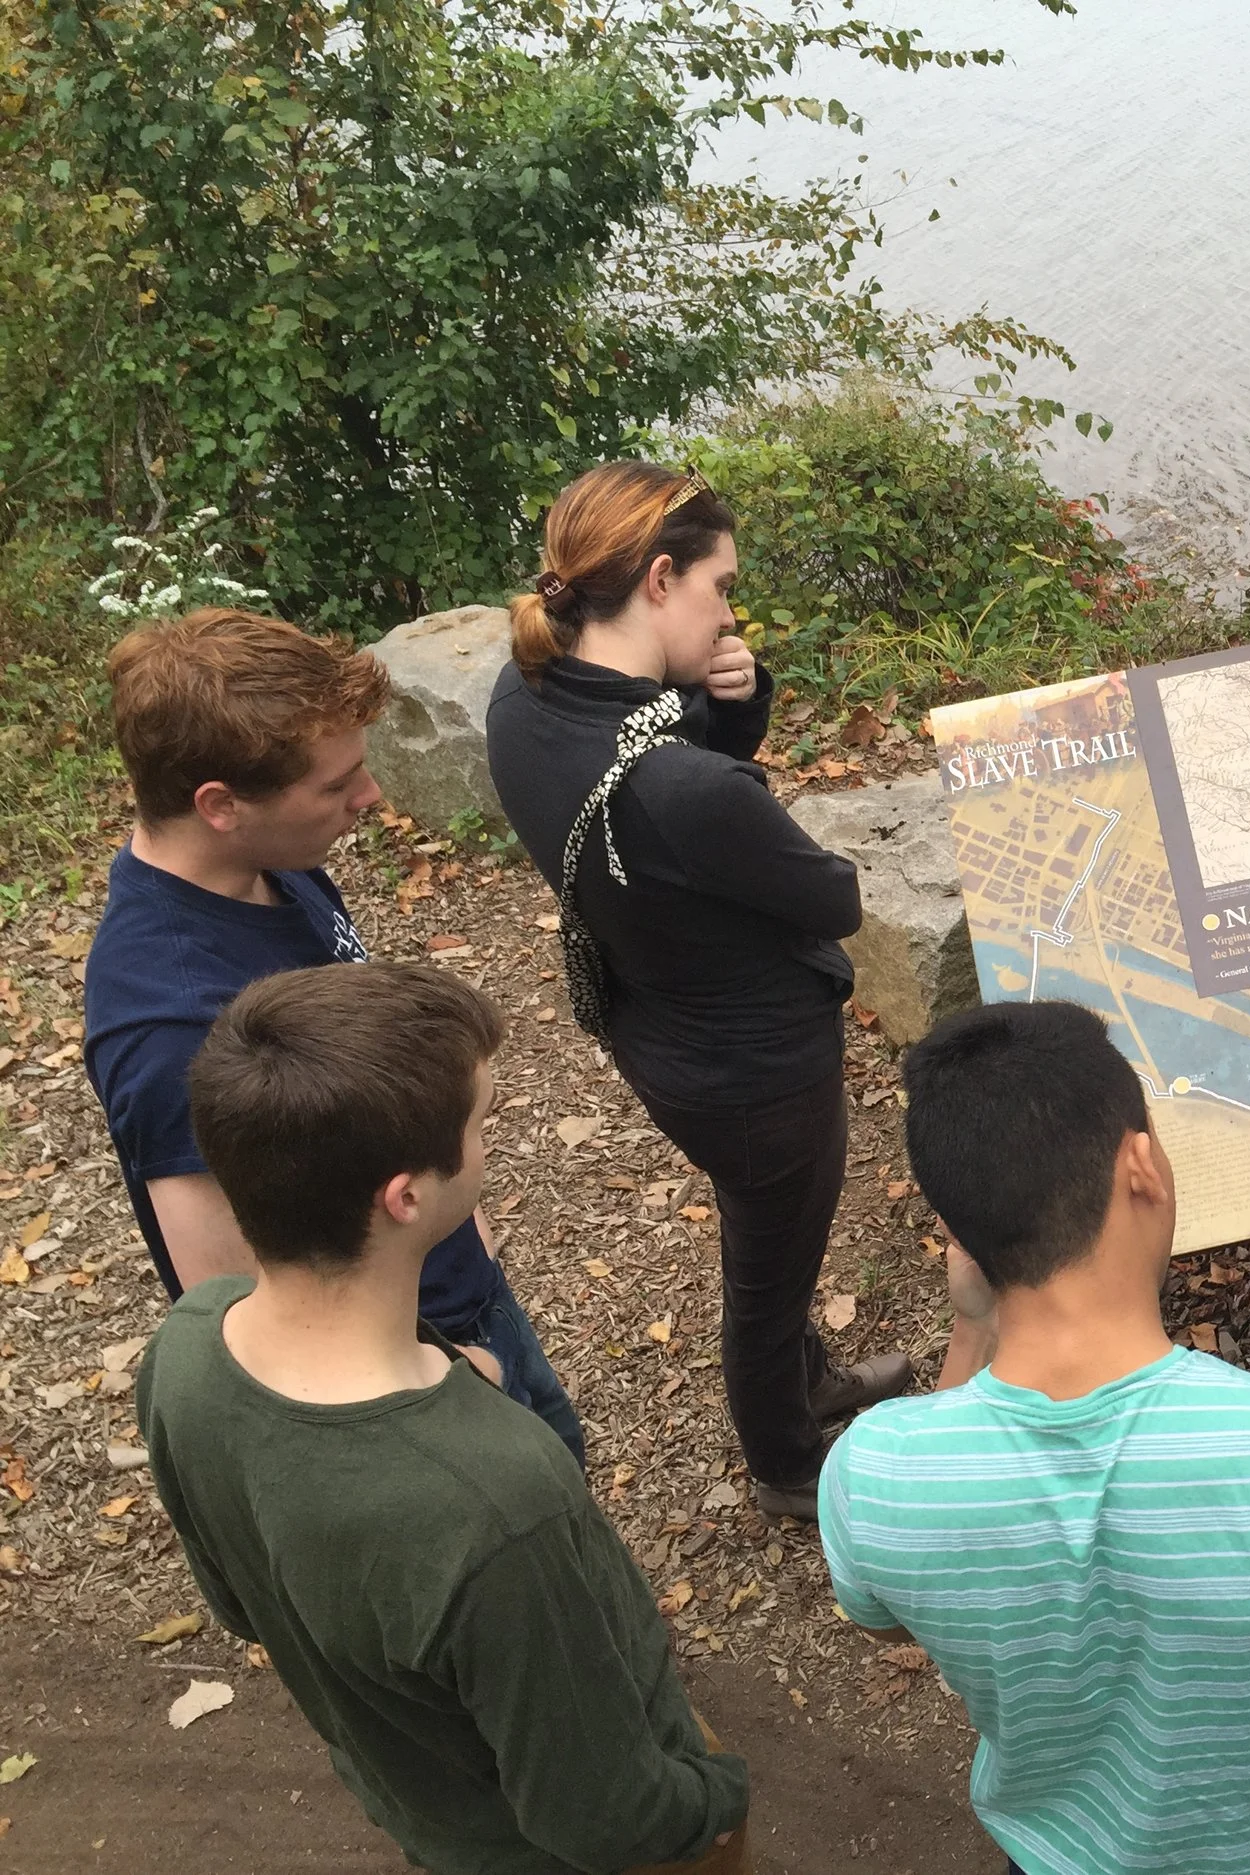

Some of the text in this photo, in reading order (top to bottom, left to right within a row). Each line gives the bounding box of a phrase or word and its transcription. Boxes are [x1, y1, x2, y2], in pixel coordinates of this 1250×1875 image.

[965, 734, 1036, 760] Richmond
[948, 730, 1136, 794] SLAVE TRAIL
[1211, 950, 1227, 960] she
[1228, 948, 1245, 956] has
[1220, 966, 1249, 978] General
